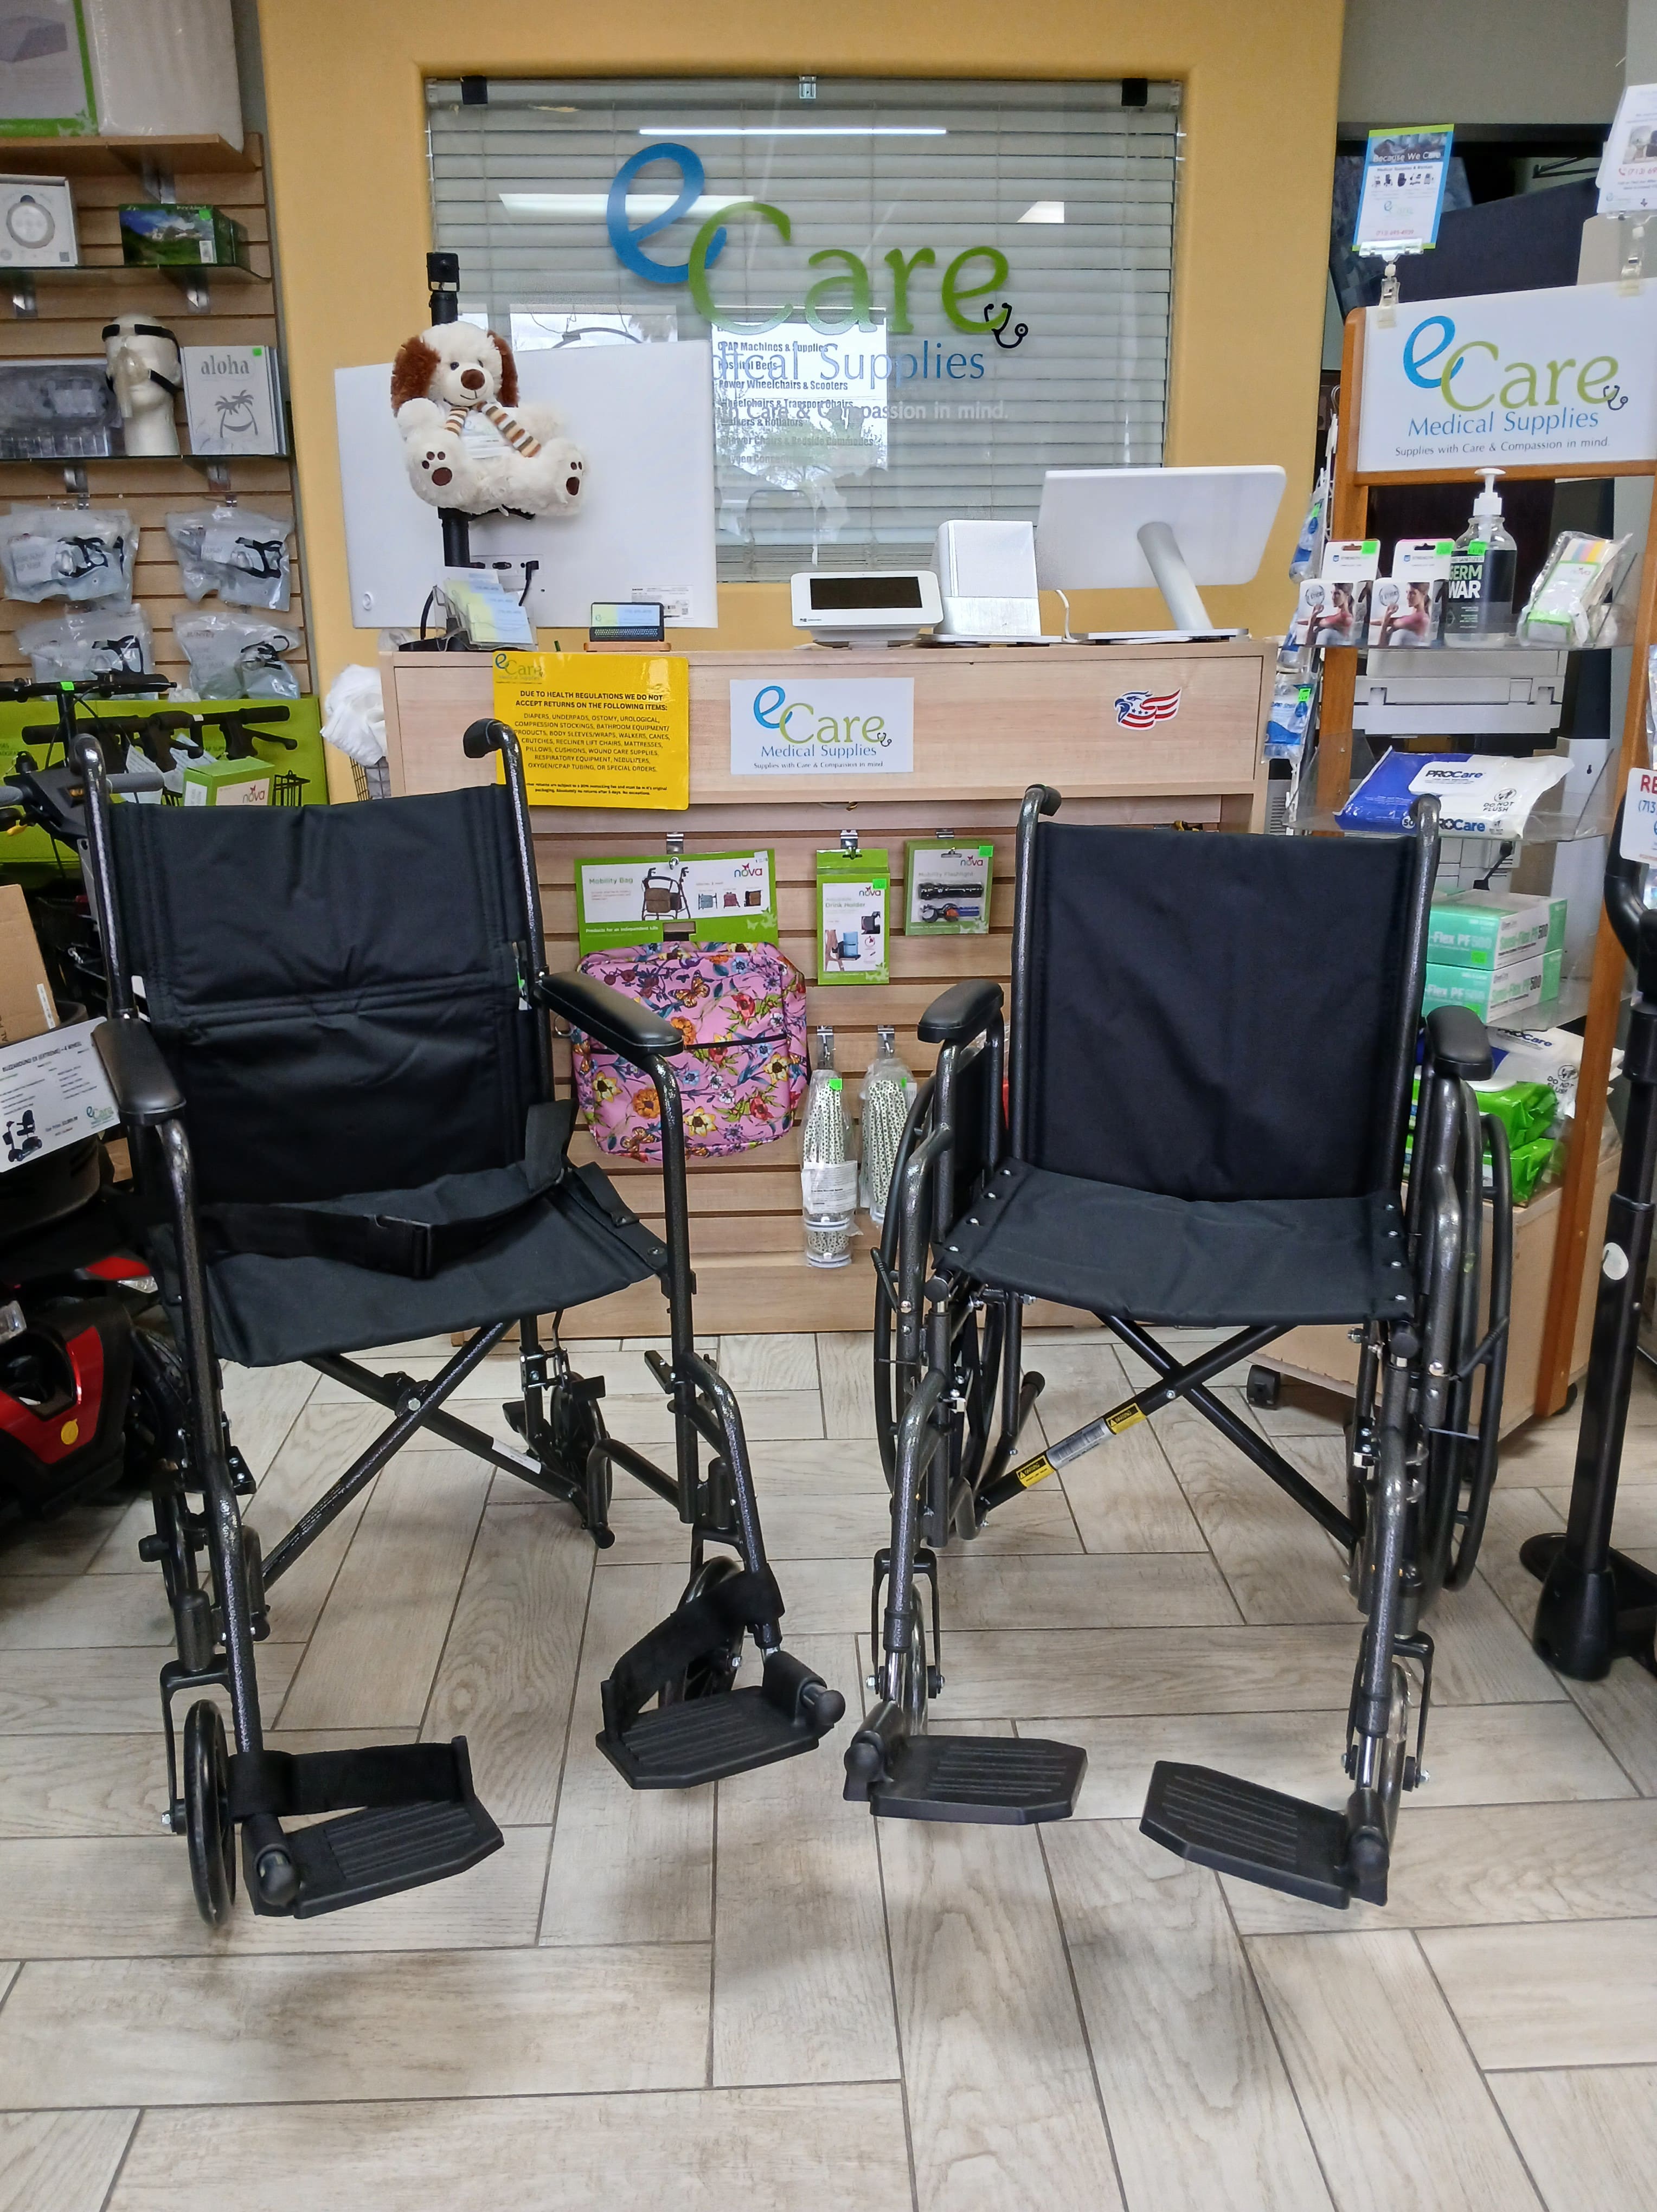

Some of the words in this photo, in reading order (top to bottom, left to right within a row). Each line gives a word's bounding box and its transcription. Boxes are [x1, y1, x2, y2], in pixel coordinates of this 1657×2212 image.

[1373, 154, 1405, 163] Because
[1407, 152, 1421, 160] We
[1422, 151, 1441, 159] Care
[607, 142, 1009, 336] eCare
[741, 343, 782, 351] Machines
[201, 354, 250, 376] aloha
[712, 340, 798, 380] dical
[820, 340, 985, 390] Supplies
[718, 360, 753, 370] Hosital
[756, 361, 777, 370] Beds
[1403, 316, 1619, 412] eCare
[719, 380, 744, 389] Power
[747, 380, 801, 389] Wheelchairs
[811, 381, 848, 390] Scooters
[721, 398, 775, 408] heelchairs
[818, 400, 929, 423] Cpassion
[935, 402, 952, 419] in
[958, 400, 1008, 420] mind.
[1408, 411, 1494, 436] Medical
[1504, 407, 1598, 435] Supplies
[1395, 442, 1434, 457] Supplies
[1438, 443, 1459, 455] with
[1462, 443, 1485, 453] Care
[1489, 443, 1496, 452] &
[1501, 440, 1562, 455] Compassion
[1567, 440, 1576, 448] in
[1449, 564, 1483, 580] GERM
[1448, 580, 1481, 599] WAR
[754, 685, 885, 744] eCare
[761, 744, 814, 758] Medical
[821, 744, 877, 758] Supplies
[754, 762, 779, 770] Supplies
[820, 762, 857, 770] Compassion
[1425, 770, 1483, 779] PROCare
[242, 790, 265, 803] nova
[1439, 818, 1485, 832] ROCare
[734, 867, 763, 878] nova
[589, 877, 617, 886] Mobility
[619, 877, 633, 885] Bag
[859, 889, 881, 897] nova
[1498, 1029, 1553, 1047] OCare
